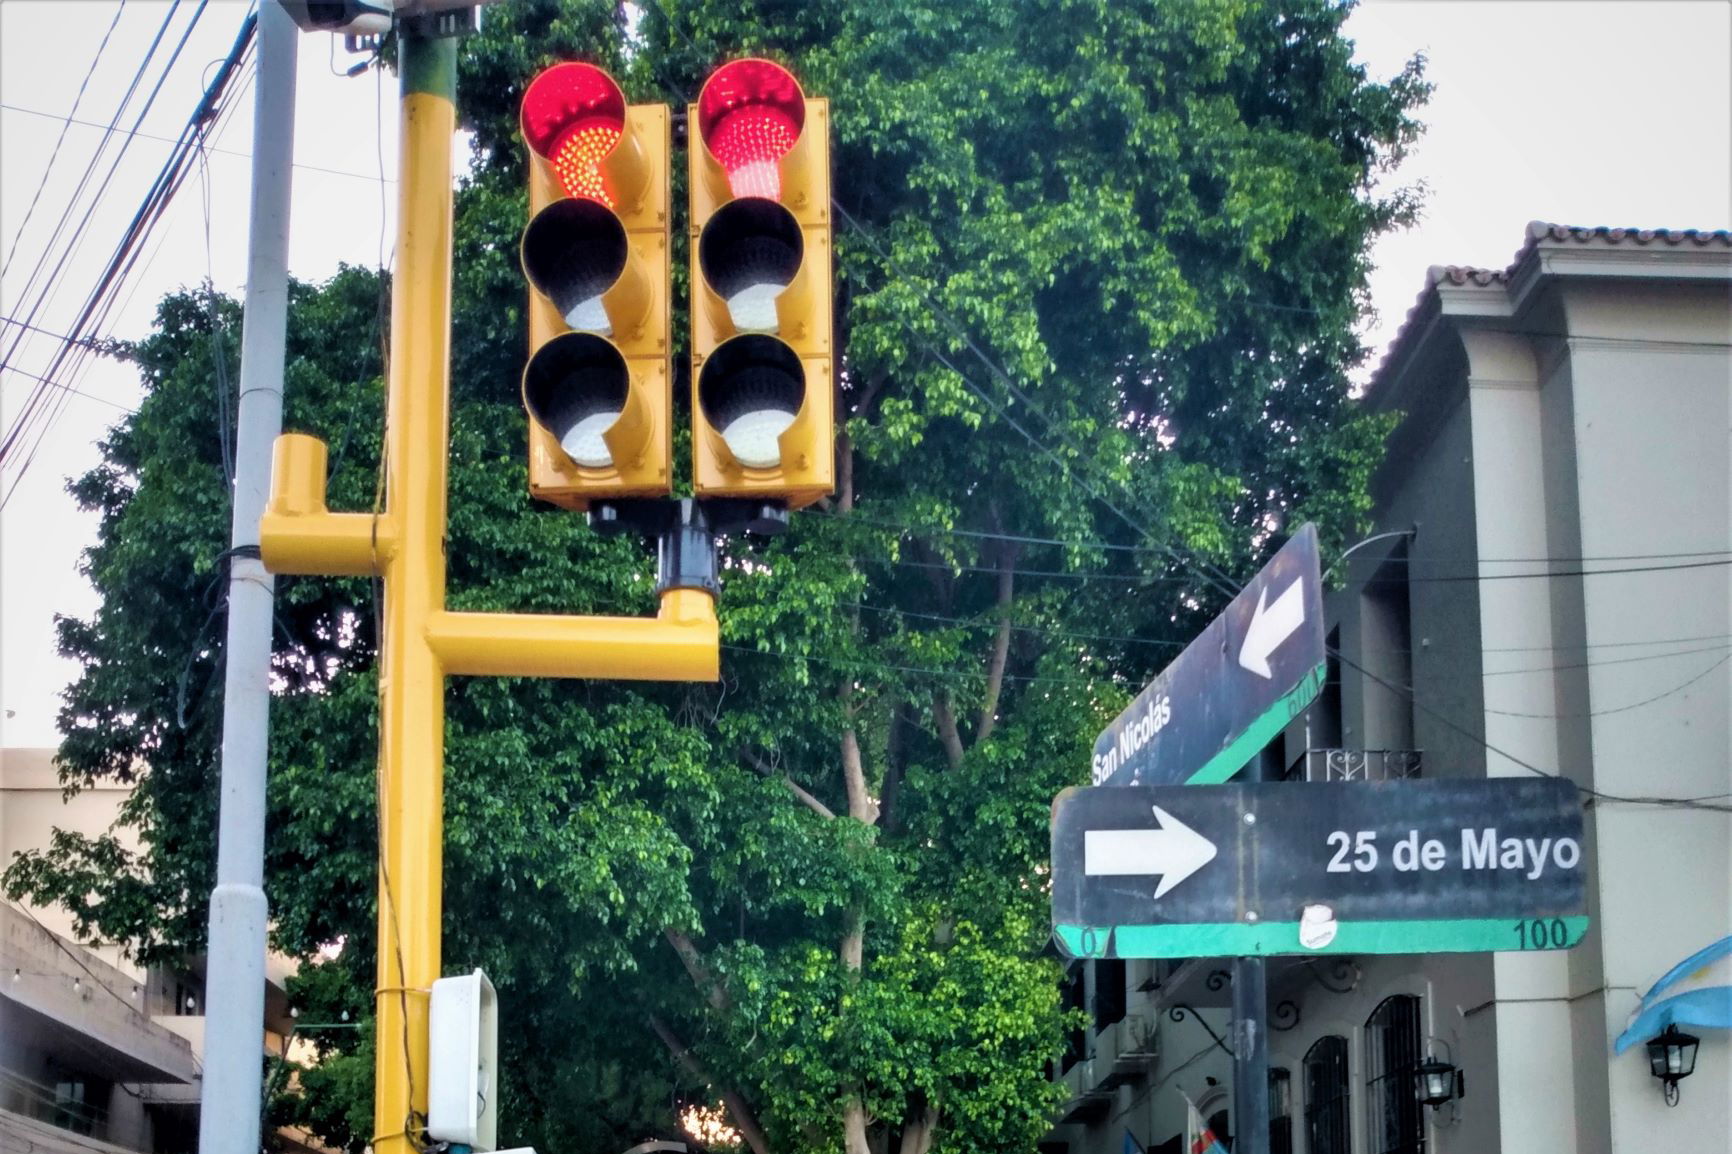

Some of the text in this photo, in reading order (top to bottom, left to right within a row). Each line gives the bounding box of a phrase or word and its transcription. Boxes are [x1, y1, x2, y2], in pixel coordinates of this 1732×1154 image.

[1093, 693, 1171, 787] San Nicolás
[1326, 828, 1580, 880] 25 de Mayo
[1514, 918, 1568, 949] 100
